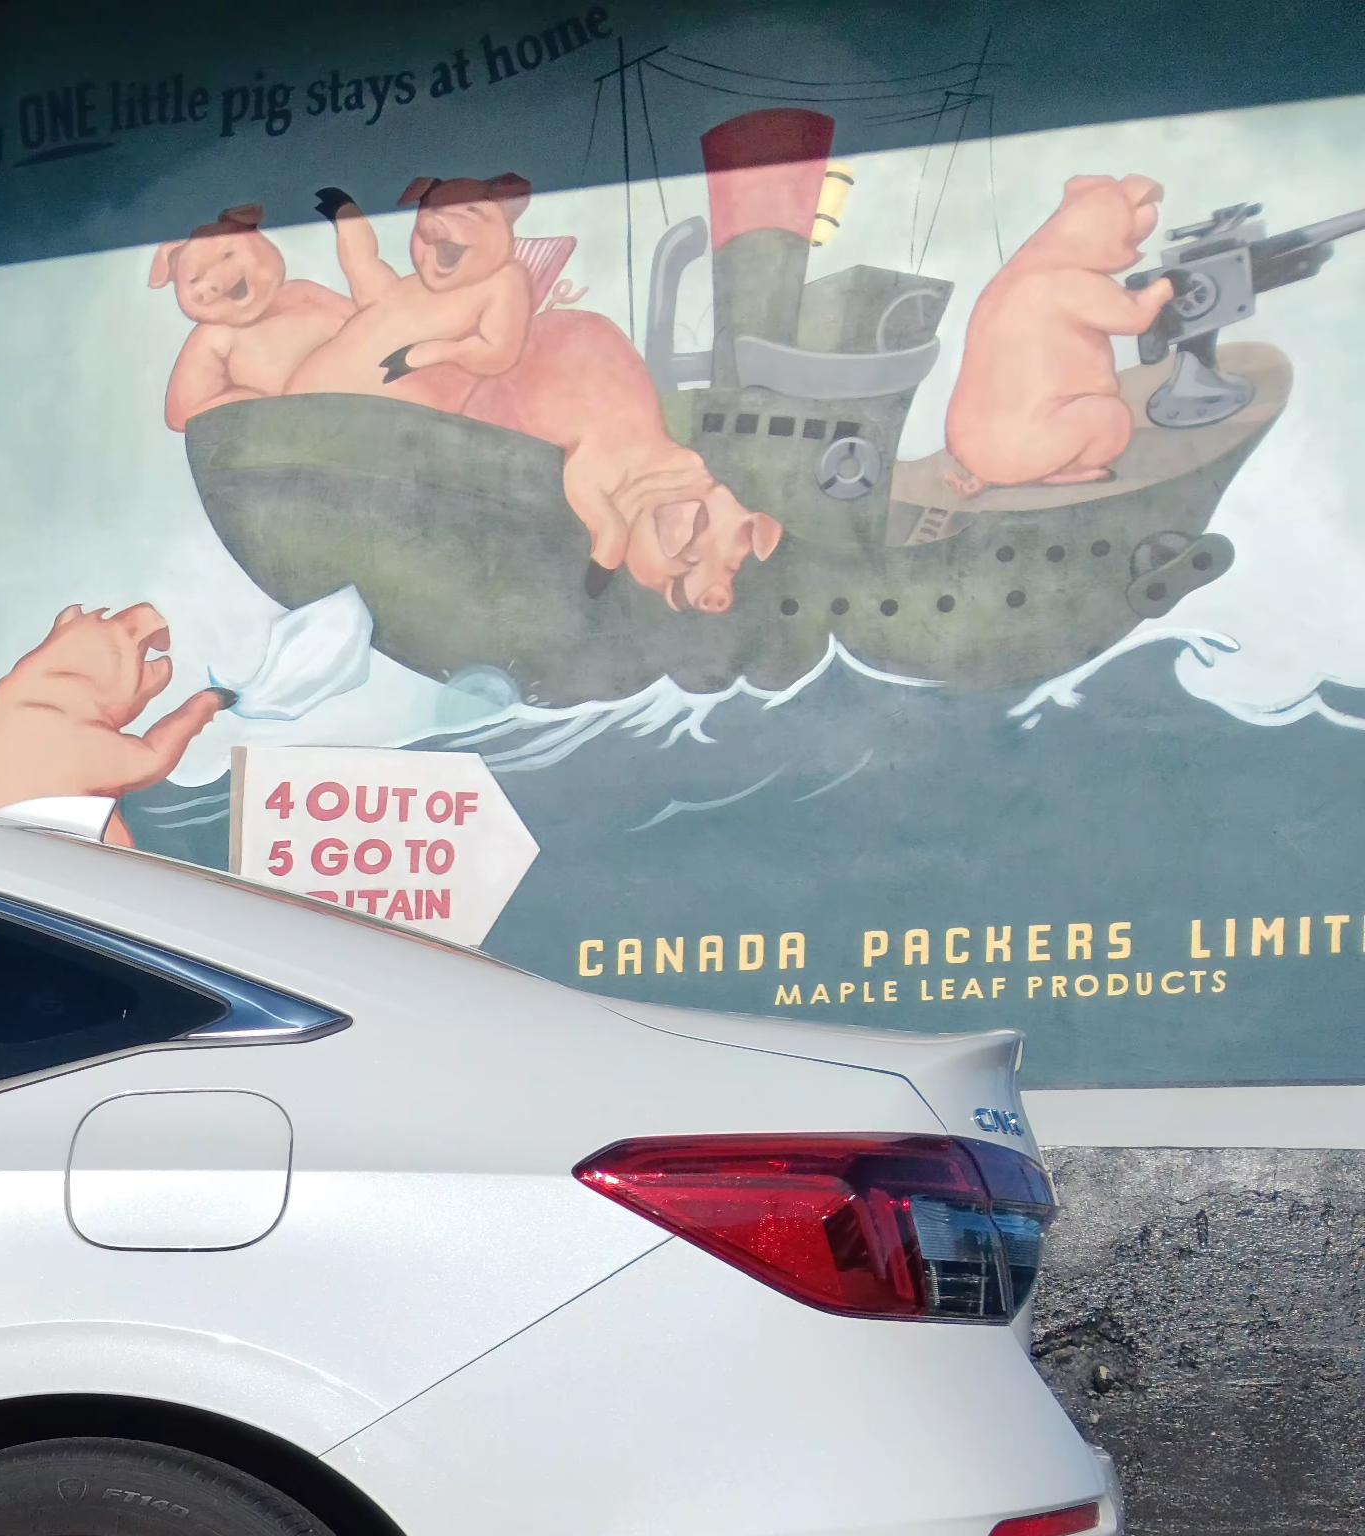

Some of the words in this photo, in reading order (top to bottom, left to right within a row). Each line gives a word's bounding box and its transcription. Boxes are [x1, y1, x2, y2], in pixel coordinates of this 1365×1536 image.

[19, 80, 98, 150] ONE
[110, 73, 209, 132] little
[220, 71, 296, 137] pig
[306, 68, 417, 126] stays
[429, 48, 473, 99] at
[480, 6, 614, 85] home
[265, 781, 295, 820] 4
[305, 781, 418, 824] OUT
[425, 789, 479, 826] OF
[268, 839, 294, 877] 5
[310, 837, 393, 877] GO
[404, 838, 455, 876] TO
[578, 932, 806, 978] CANADA
[863, 921, 1132, 968] PACKERS
[1190, 914, 1365, 959] LIMIT
[774, 980, 899, 1006] MAPLE
[920, 977, 1007, 1001] LEAF
[1027, 969, 1228, 998] PRODUCTS
